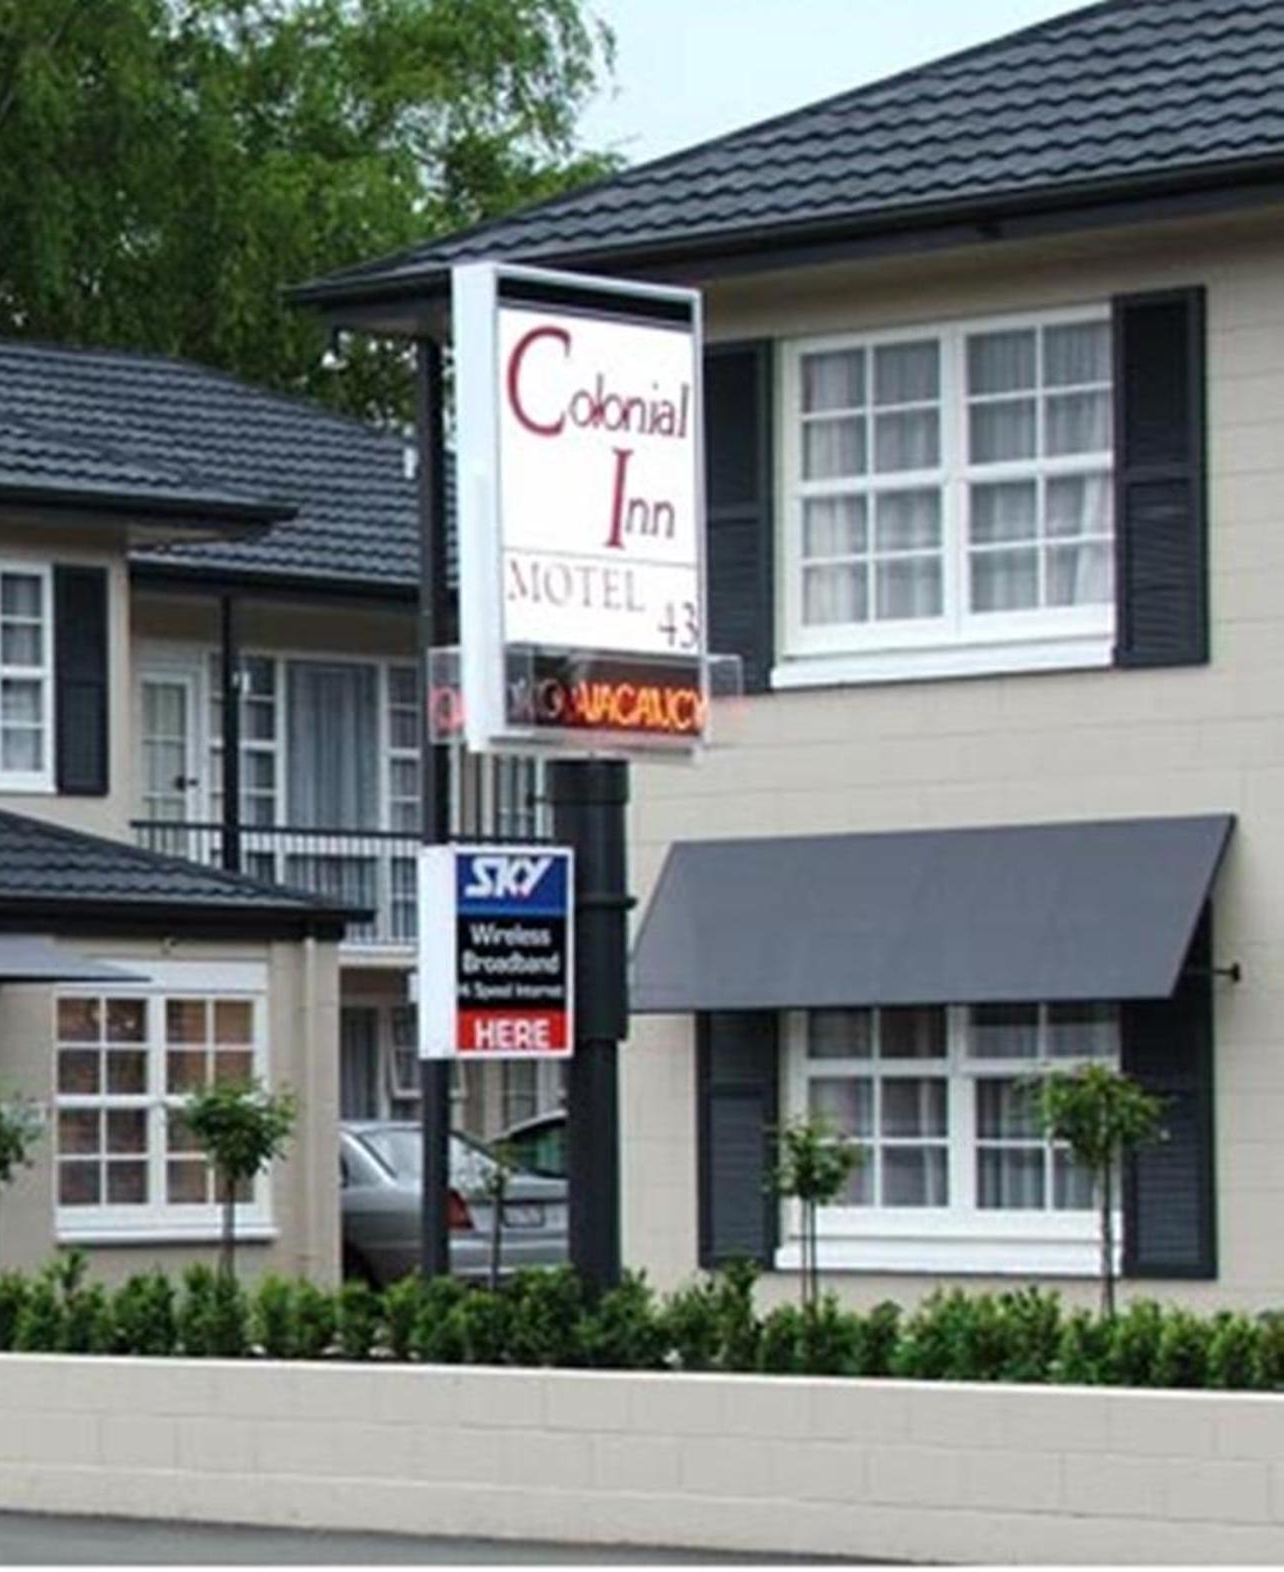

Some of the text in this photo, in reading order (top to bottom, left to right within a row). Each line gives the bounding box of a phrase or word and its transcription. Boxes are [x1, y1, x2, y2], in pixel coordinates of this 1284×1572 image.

[506, 326, 689, 438] Colonial
[605, 448, 676, 549] Inn
[507, 560, 645, 613] MOTEL
[657, 601, 699, 651] 43
[463, 856, 554, 898] SKY
[469, 922, 552, 947] Wireless
[461, 949, 560, 975] Broadband
[474, 1018, 551, 1048] HERE
